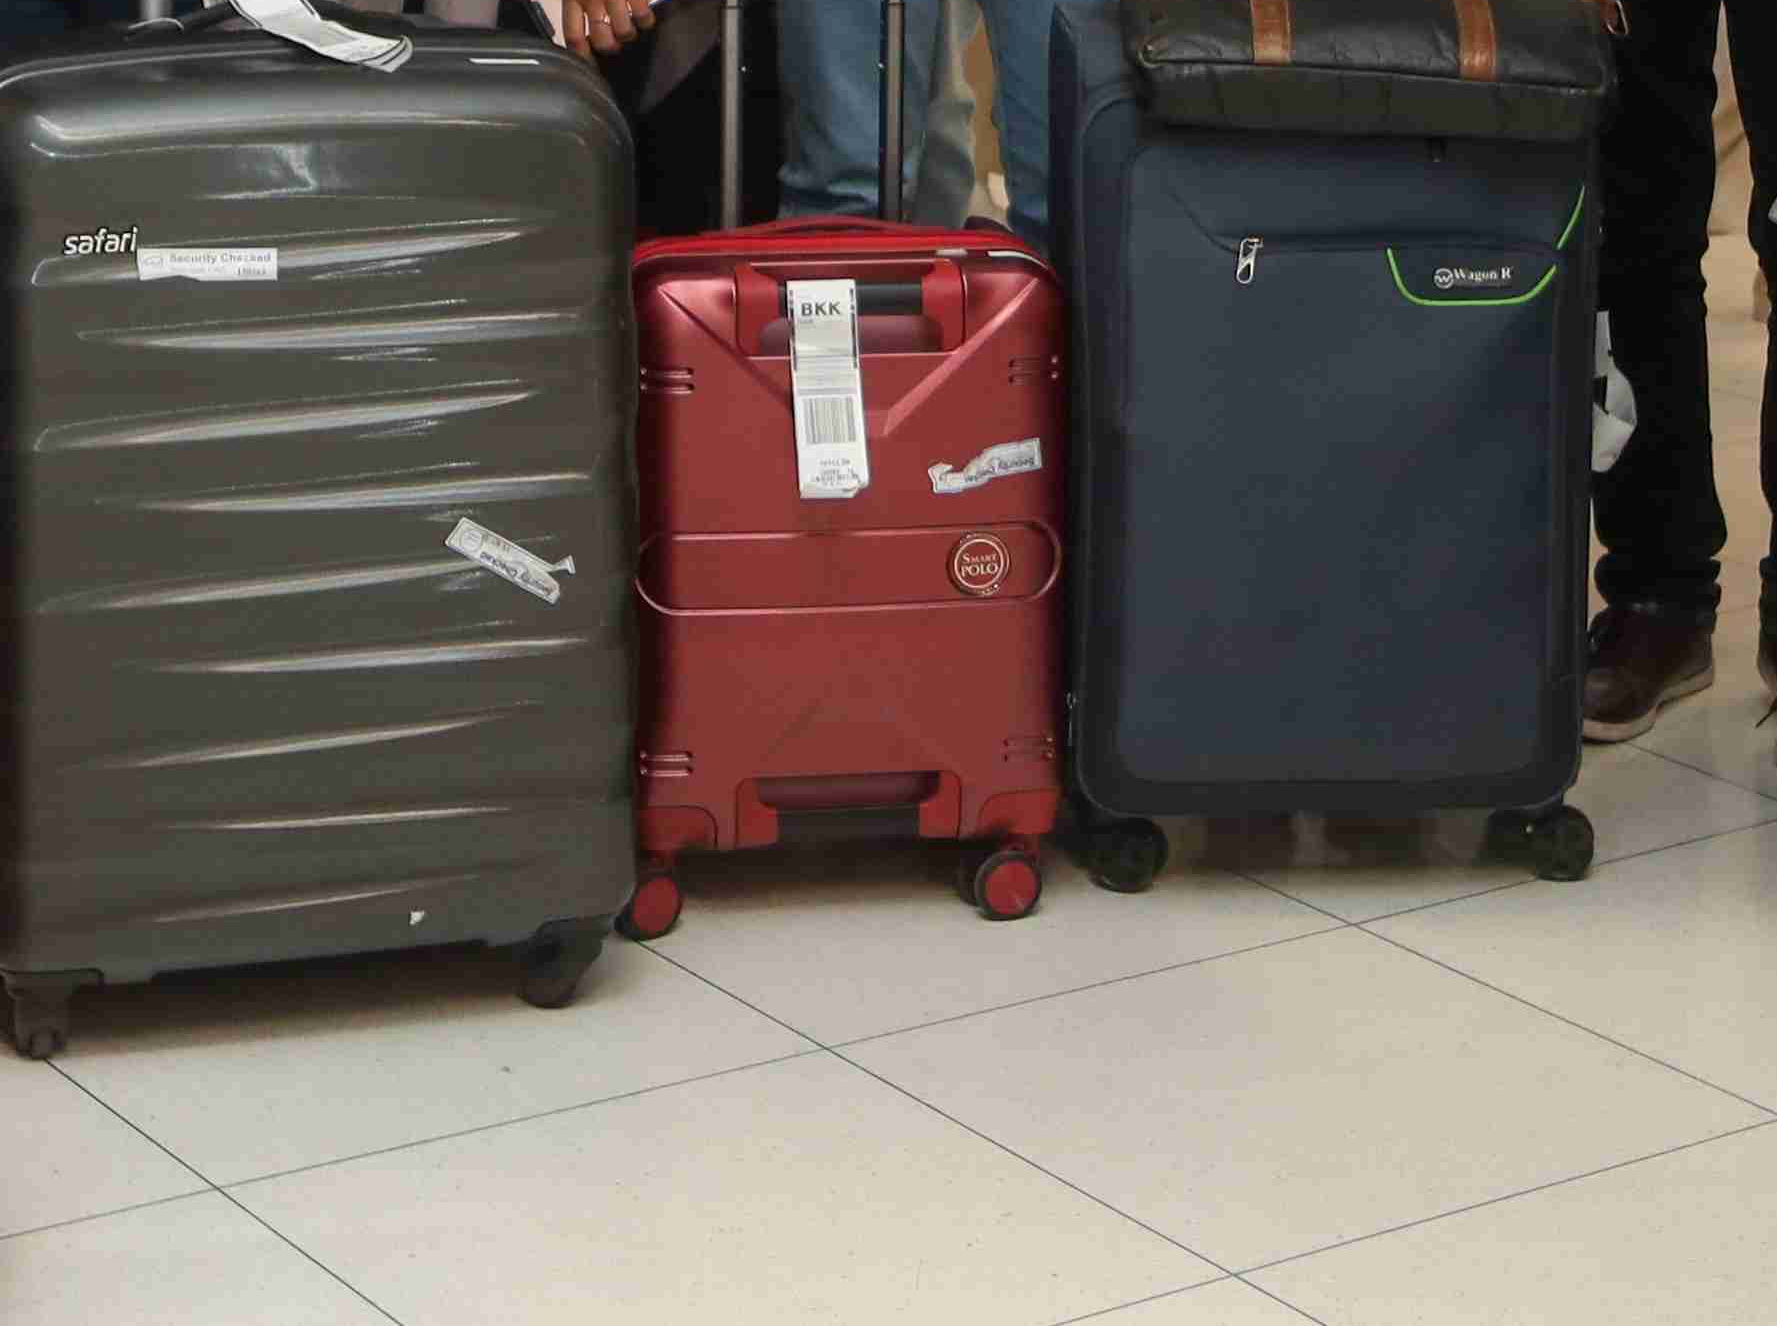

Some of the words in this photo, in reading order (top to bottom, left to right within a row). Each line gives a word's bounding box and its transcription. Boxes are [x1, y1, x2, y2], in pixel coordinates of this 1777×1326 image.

[63, 225, 139, 255] safari
[801, 300, 842, 317] BKK
[960, 562, 1000, 578] POLO
